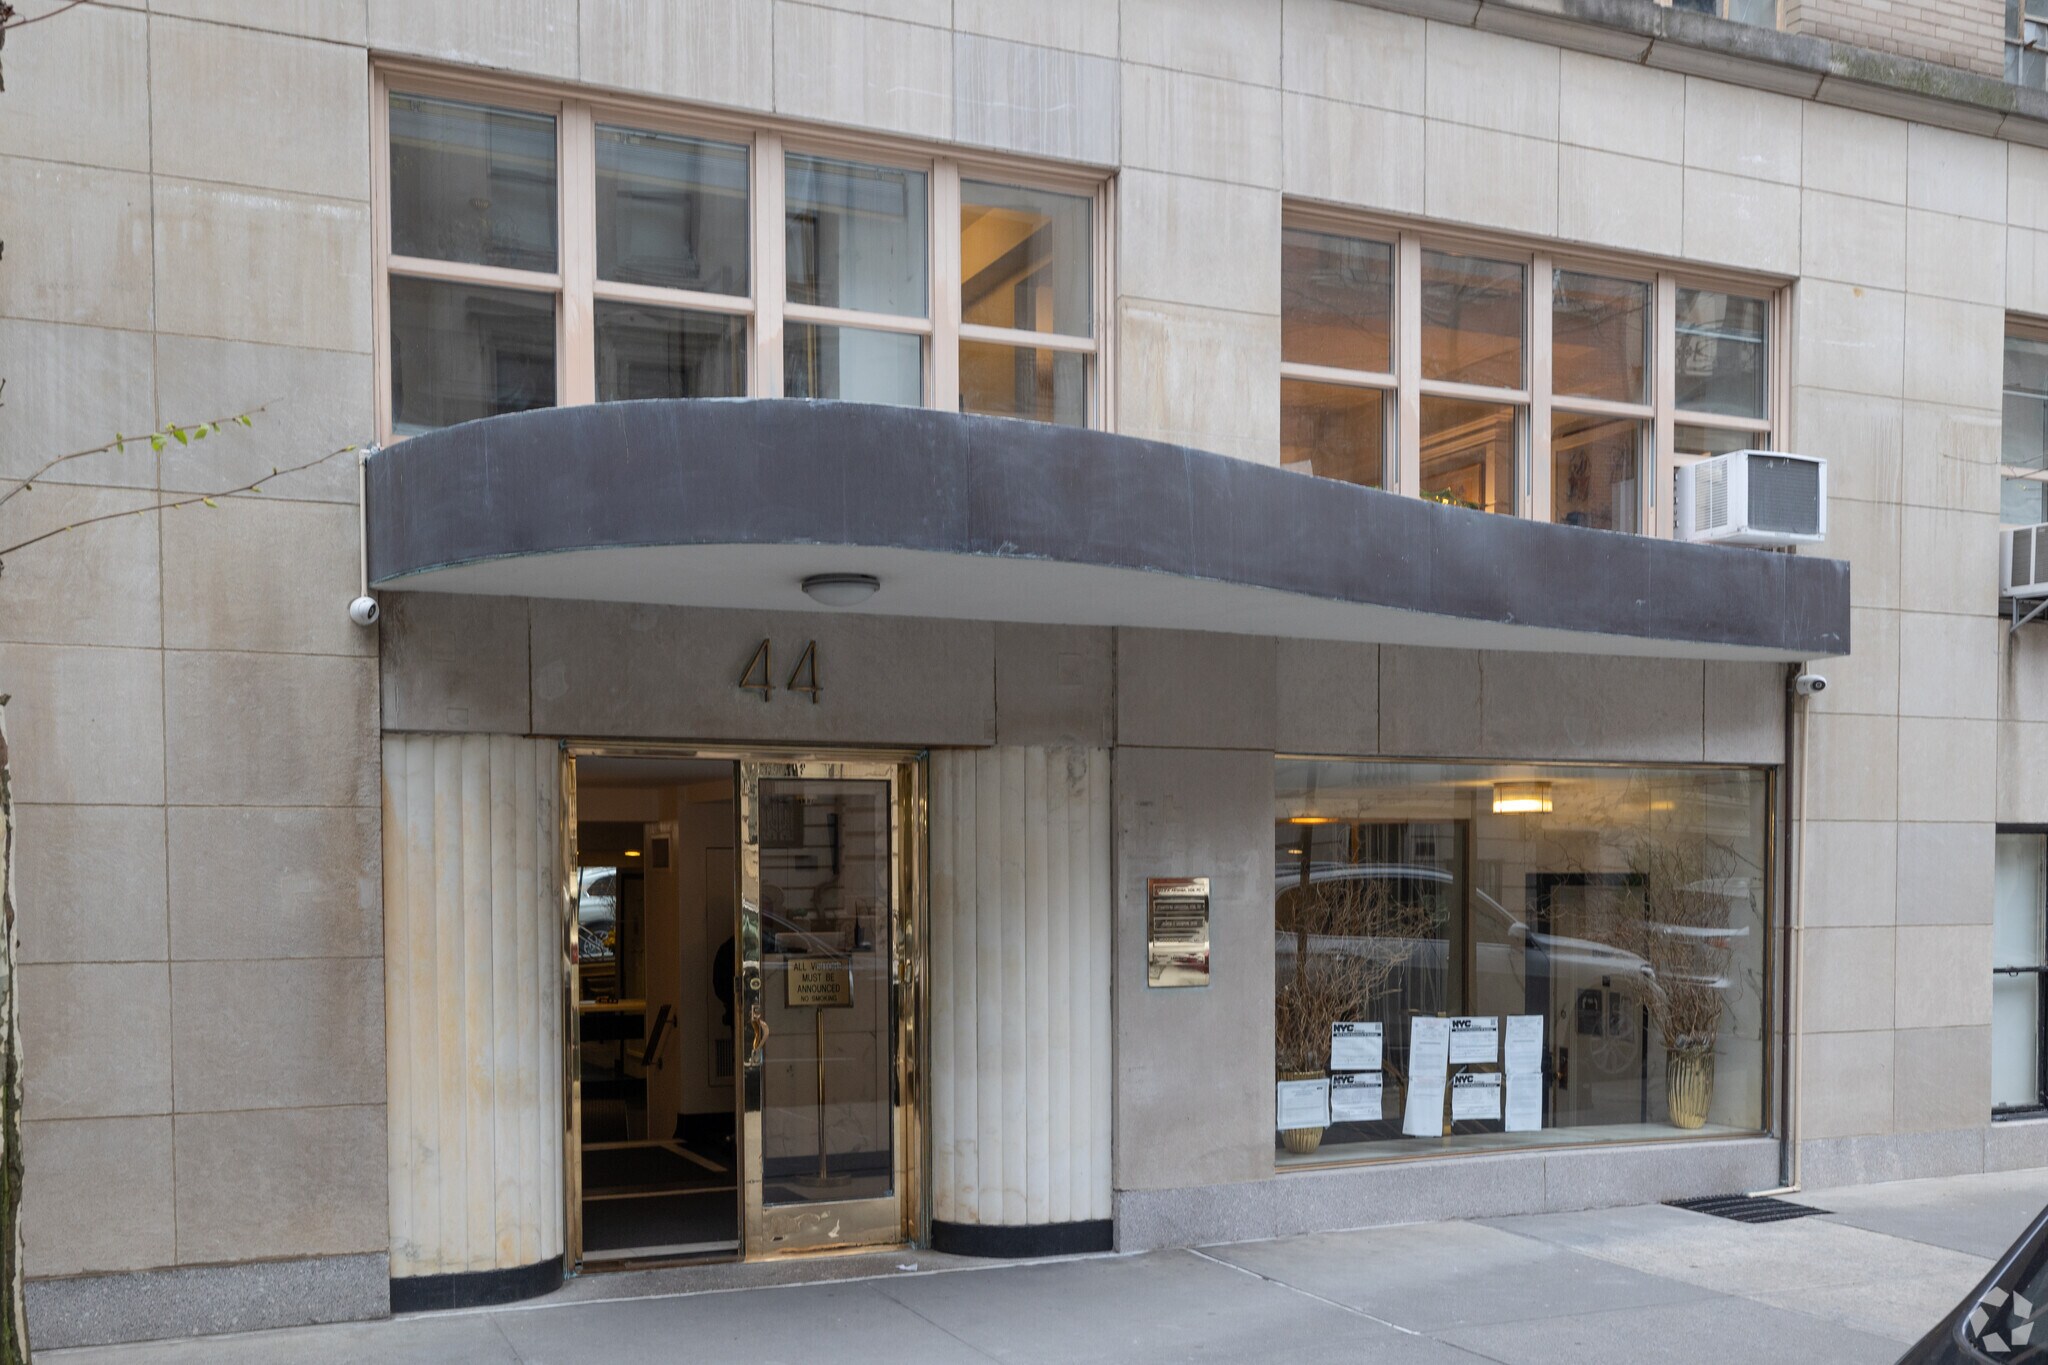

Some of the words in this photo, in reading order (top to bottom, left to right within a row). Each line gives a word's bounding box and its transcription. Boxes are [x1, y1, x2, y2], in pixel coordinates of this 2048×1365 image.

[739, 638, 824, 704] 44
[793, 962, 807, 971] ALL
[802, 973, 821, 982] MUST
[825, 973, 835, 982] BE
[797, 984, 840, 993] ANNOUNCED
[1333, 1024, 1354, 1032] NYC
[1452, 1020, 1471, 1028] NYC
[1333, 1075, 1354, 1084] NYC
[1455, 1075, 1473, 1083] NYC
